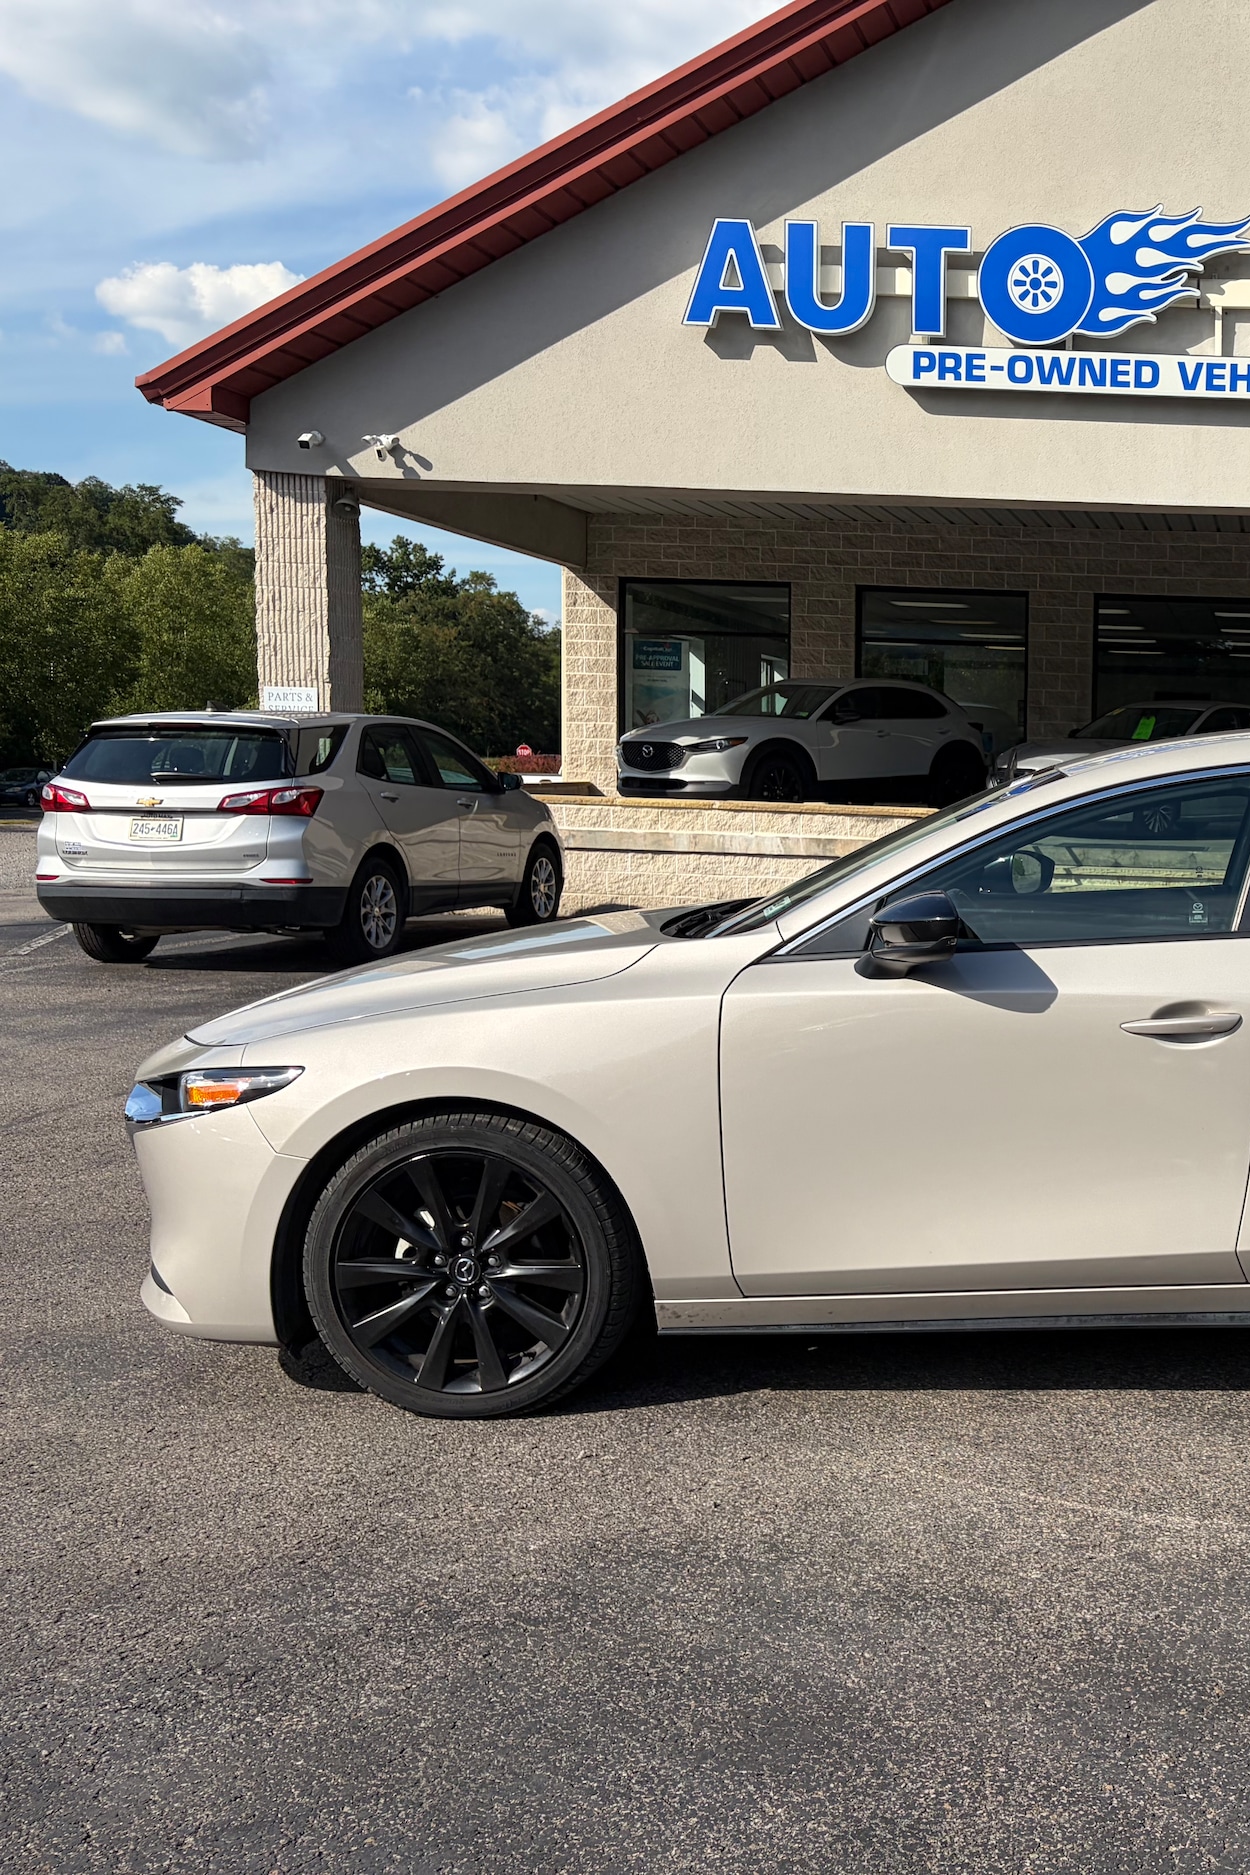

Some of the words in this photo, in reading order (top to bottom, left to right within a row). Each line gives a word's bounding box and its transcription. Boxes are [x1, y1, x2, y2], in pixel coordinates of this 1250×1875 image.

[682, 217, 1095, 345] AUTO
[912, 352, 1160, 390] PRE-OWNED
[267, 691, 303, 702] PARTS
[305, 692, 313, 702] &
[518, 748, 530, 756] STOP
